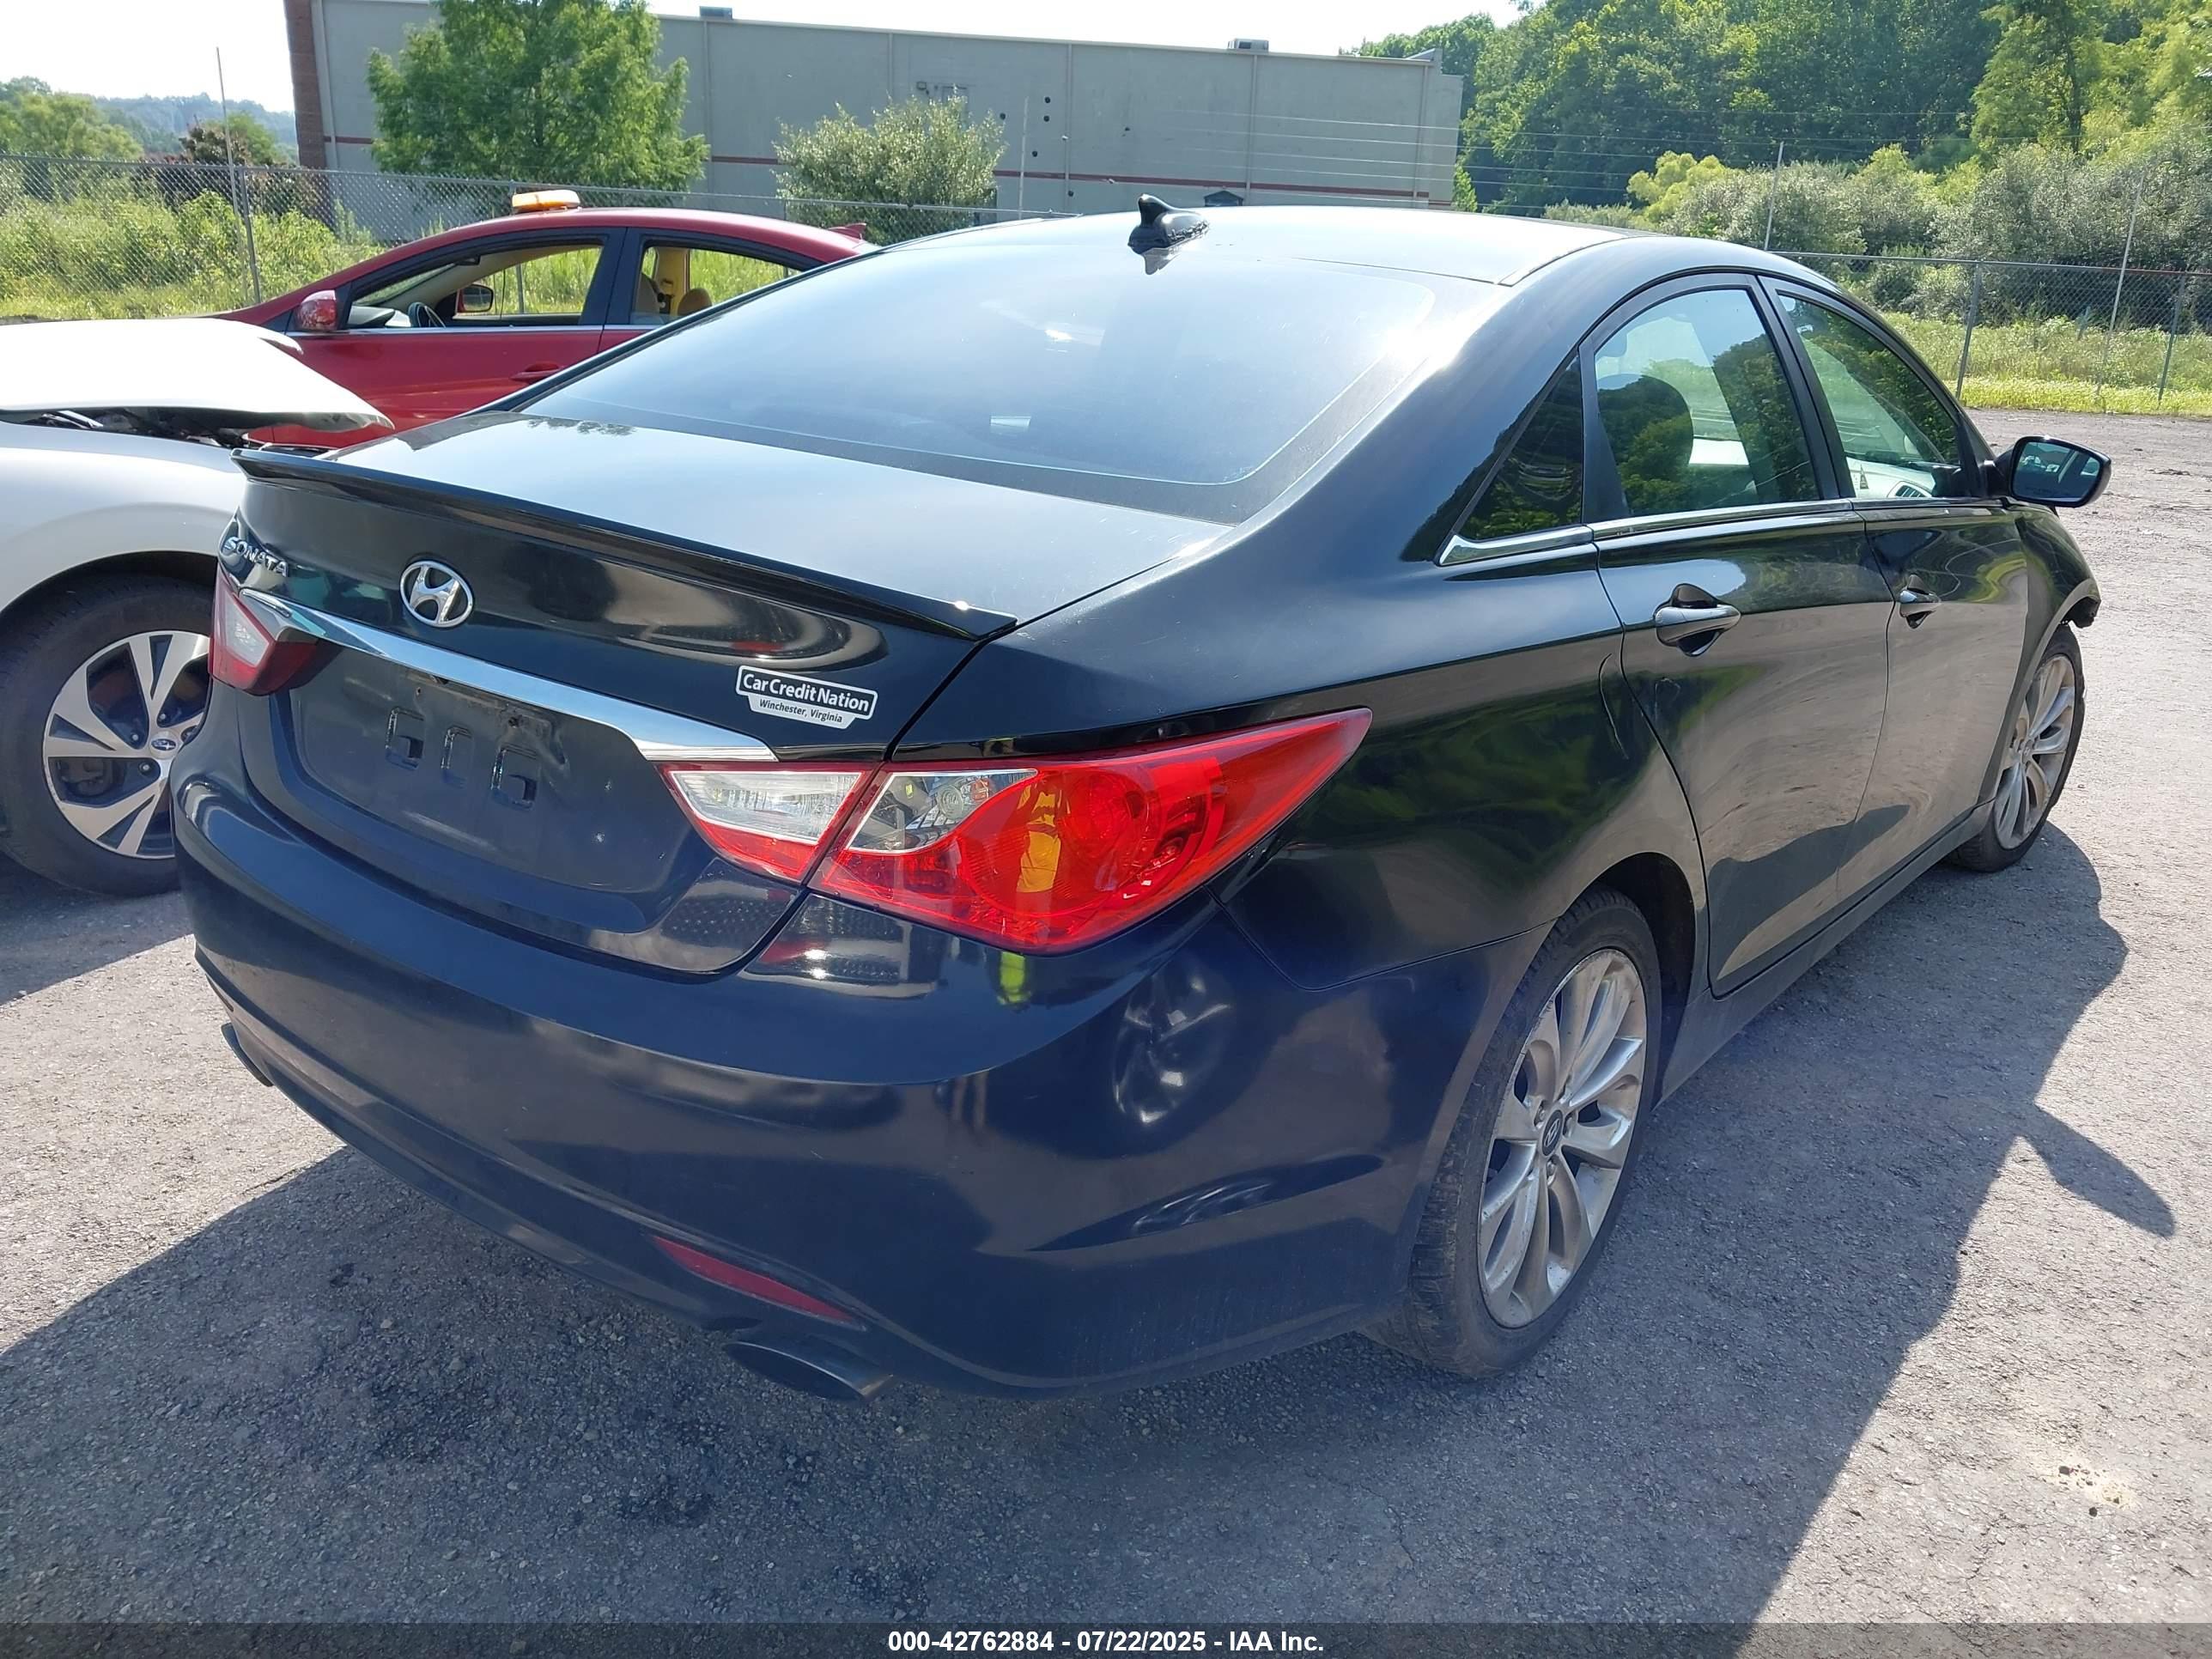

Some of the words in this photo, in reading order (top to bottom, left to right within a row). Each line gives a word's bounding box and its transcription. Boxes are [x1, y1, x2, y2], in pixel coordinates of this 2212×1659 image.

[222, 536, 289, 577] SONATA
[759, 698, 808, 718] Winchester,
[810, 708, 843, 723] Virginia
